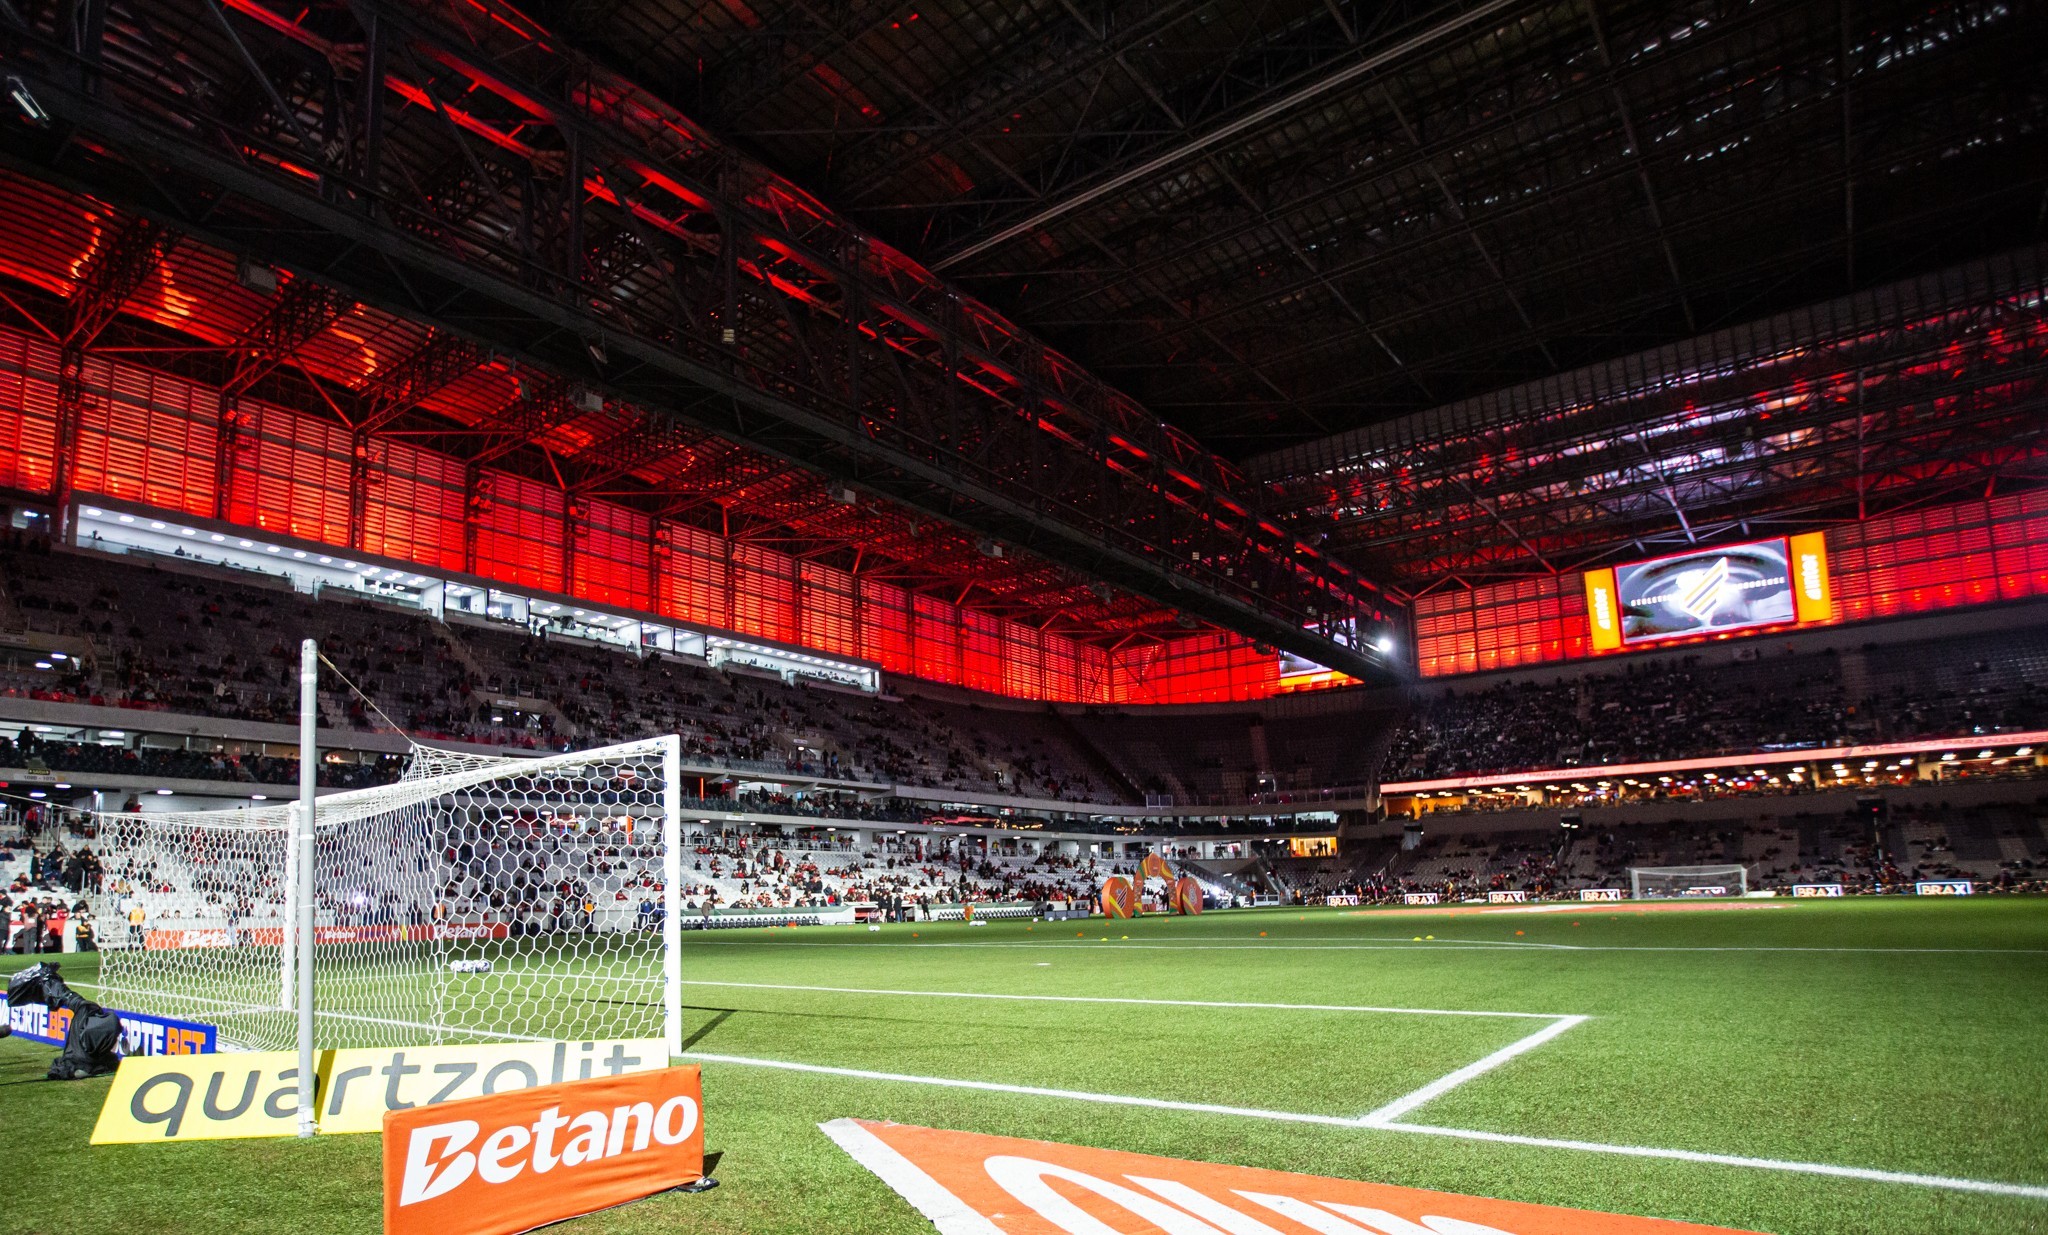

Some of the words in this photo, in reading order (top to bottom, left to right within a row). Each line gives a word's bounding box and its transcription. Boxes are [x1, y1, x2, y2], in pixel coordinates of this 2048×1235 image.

[1797, 887, 1838, 897] BRAX
[1921, 884, 1967, 895] BRAX
[1329, 896, 1355, 907] BRAX
[1408, 895, 1436, 905] BRAX
[1492, 893, 1522, 903] BRAX
[1584, 891, 1617, 901] BRAX
[433, 925, 487, 939] Betano
[10, 1003, 48, 1037] SORTE
[111, 1018, 164, 1056] ORTE
[167, 1027, 206, 1056] BET
[400, 1096, 698, 1207] Betano
